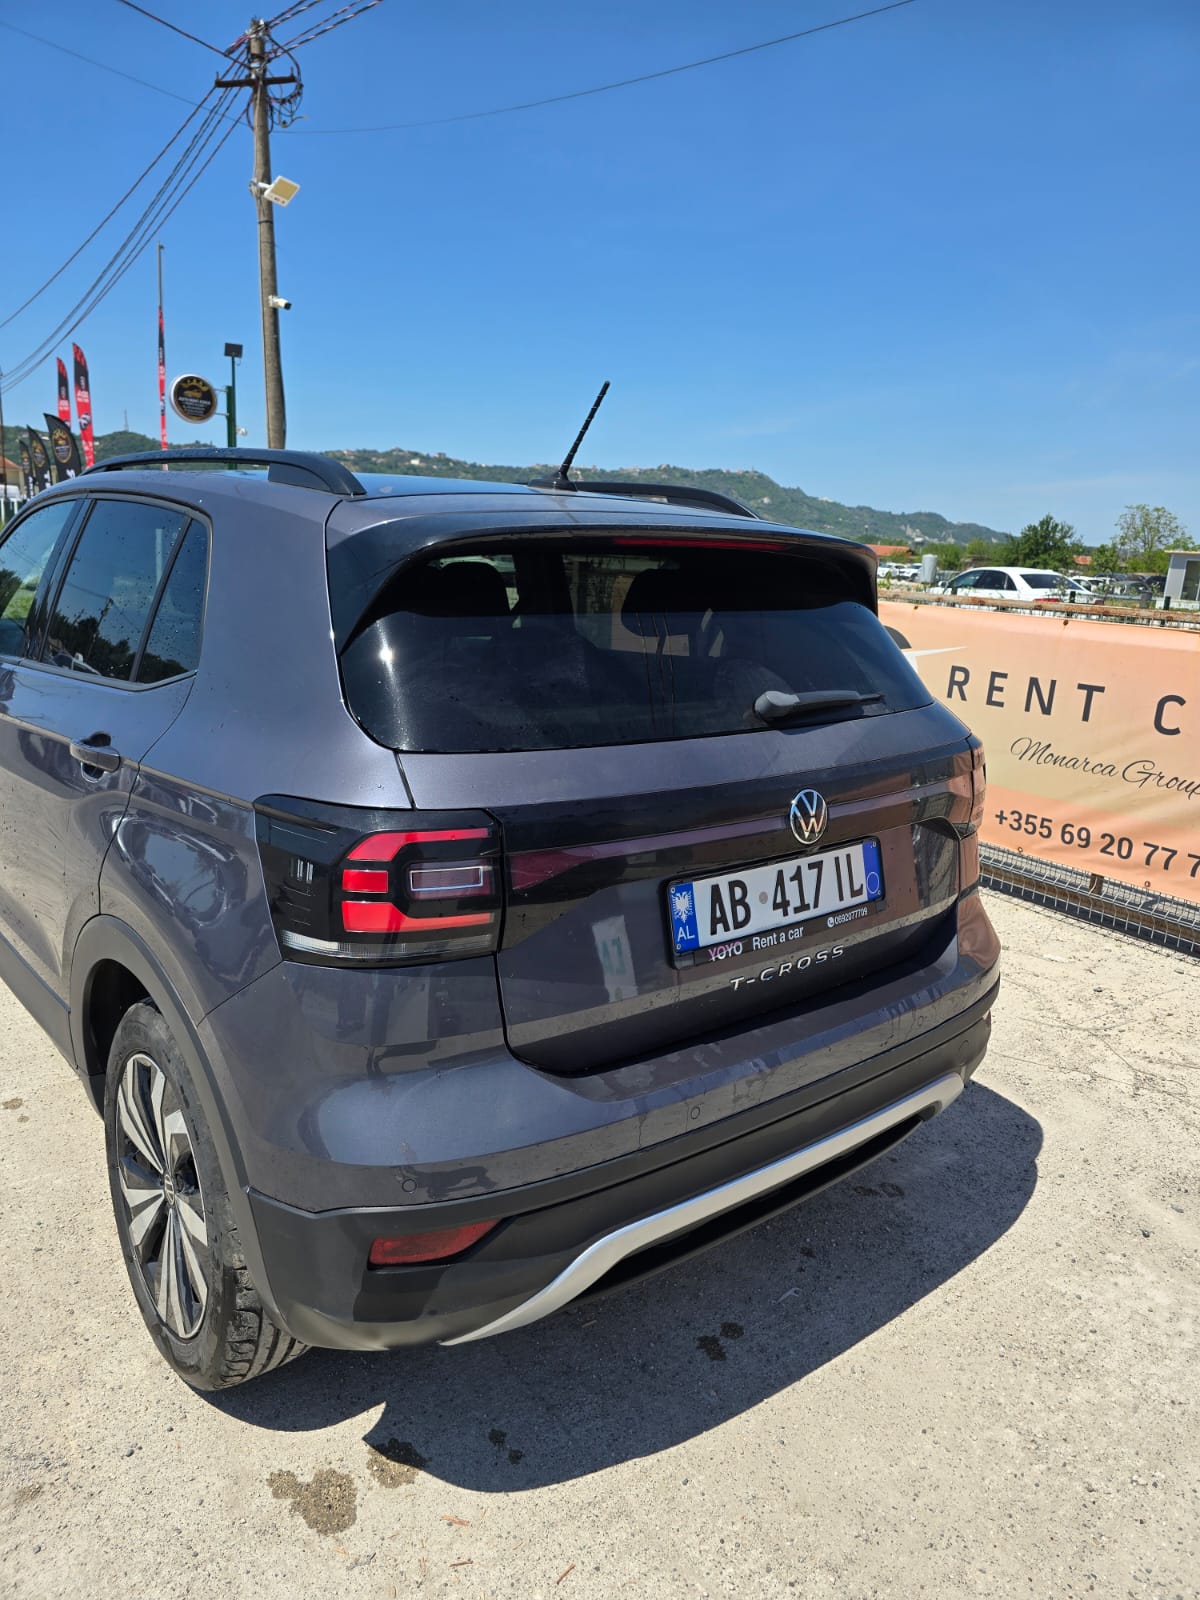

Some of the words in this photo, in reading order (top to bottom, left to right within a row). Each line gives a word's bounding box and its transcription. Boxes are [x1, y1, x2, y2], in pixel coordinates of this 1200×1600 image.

[946, 664, 1106, 723] RENT
[1153, 694, 1187, 736] C
[1010, 736, 1120, 778] Monarca
[994, 809, 1053, 839] +355
[1060, 823, 1091, 849] 69
[1099, 832, 1134, 860] 20
[1143, 842, 1178, 871] 77
[709, 879, 752, 936] AB
[772, 859, 824, 917] 417
[834, 853, 864, 902] IL
[677, 926, 696, 941] AL
[708, 941, 743, 962] YOYO
[752, 932, 778, 951] Rent
[779, 932, 786, 942] a
[788, 926, 804, 940] car
[730, 944, 844, 991] T-CROSS
